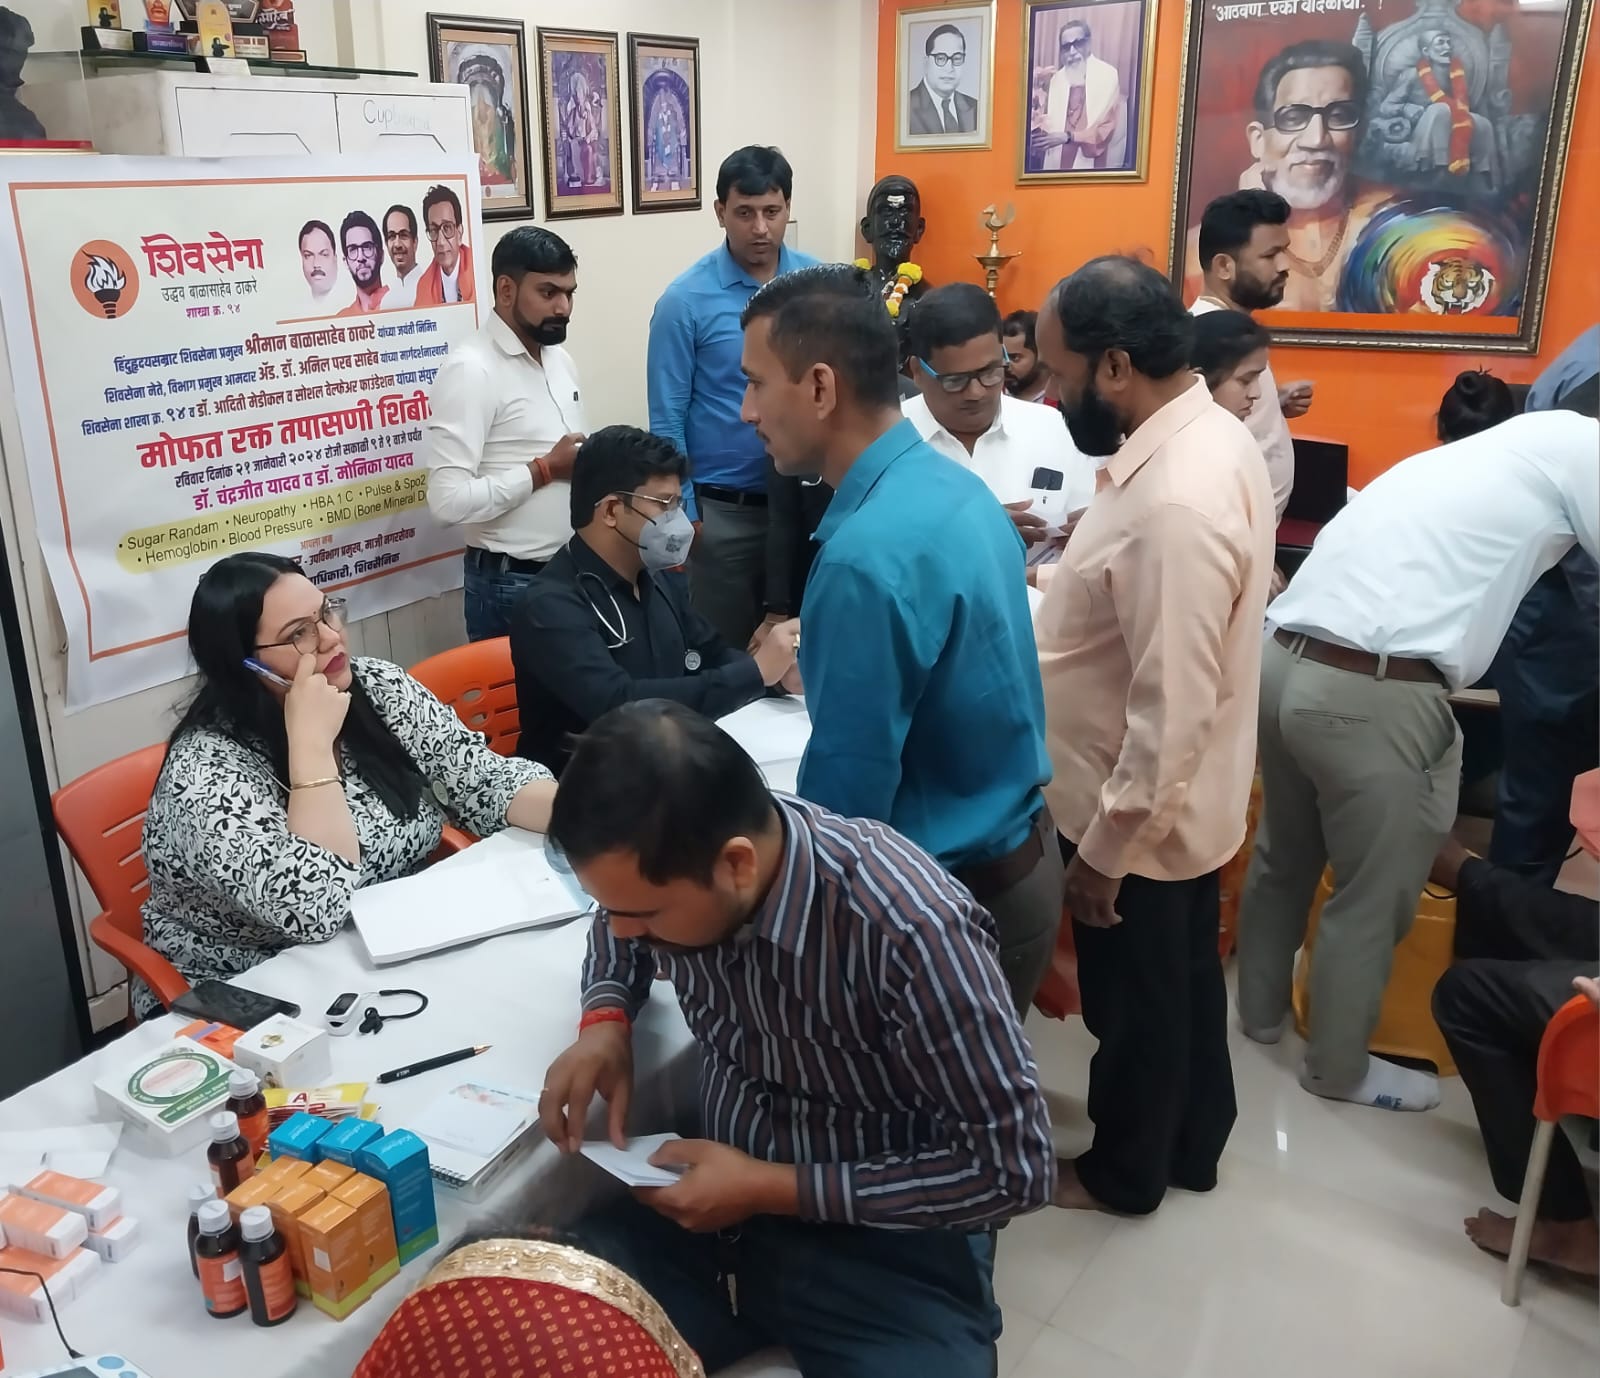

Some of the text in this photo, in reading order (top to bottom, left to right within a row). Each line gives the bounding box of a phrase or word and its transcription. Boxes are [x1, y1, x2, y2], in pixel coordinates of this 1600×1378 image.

[140, 231, 264, 279] शिवसेना
[161, 275, 258, 302] उद्धव बाळासाहेब ठाकरे
[186, 306, 210, 319] शाखा
[179, 346, 218, 364] शिवसेना
[218, 344, 244, 362] प्रमुख
[245, 333, 287, 355] श्रीमान
[288, 324, 346, 350] बाळासाहेब
[347, 319, 375, 343] ठाकरे
[104, 385, 146, 404] शिवसेना
[167, 378, 196, 396] विभाग
[197, 375, 223, 393] प्रमुख
[224, 370, 257, 386] आमदार
[280, 358, 297, 377] डॉ.
[299, 355, 331, 375] अनिल
[332, 352, 352, 371] परब
[353, 348, 380, 368] साहेब
[81, 416, 122, 436] शिवसेना
[123, 413, 150, 429] शाखा
[166, 407, 186, 422] ९४
[196, 399, 211, 417] डॉ.
[213, 393, 247, 414] आदिती
[294, 383, 324, 402] सोशल
[136, 431, 223, 468] मोफत
[227, 422, 274, 453] रक्त
[277, 398, 373, 445] तपासणी
[174, 470, 205, 488] रविवार
[205, 464, 233, 481] दिनांक
[252, 452, 287, 472] जानेवारी
[289, 449, 322, 465] २०२४
[324, 442, 342, 459] रोजी
[342, 437, 370, 455] सकाळी
[193, 452, 414, 511] डॉ. चंद्रजीत यादव व डॉ. मोनिका यादव
[127, 533, 166, 552] Sugar
[168, 521, 219, 541] Randam
[233, 502, 296, 526] Neuropathy
[310, 495, 335, 510] HBA
[345, 491, 353, 502] C
[365, 484, 392, 499] Pulse
[395, 480, 401, 491] &
[404, 474, 426, 490] Spo2
[145, 538, 218, 564] Hemoglobin
[229, 528, 261, 546] Blood
[265, 516, 313, 537] Pressure
[327, 508, 351, 524] BMD
[353, 502, 382, 520] (Bone
[383, 493, 416, 511] Mineral
[354, 552, 401, 572] शिवसैनिक
